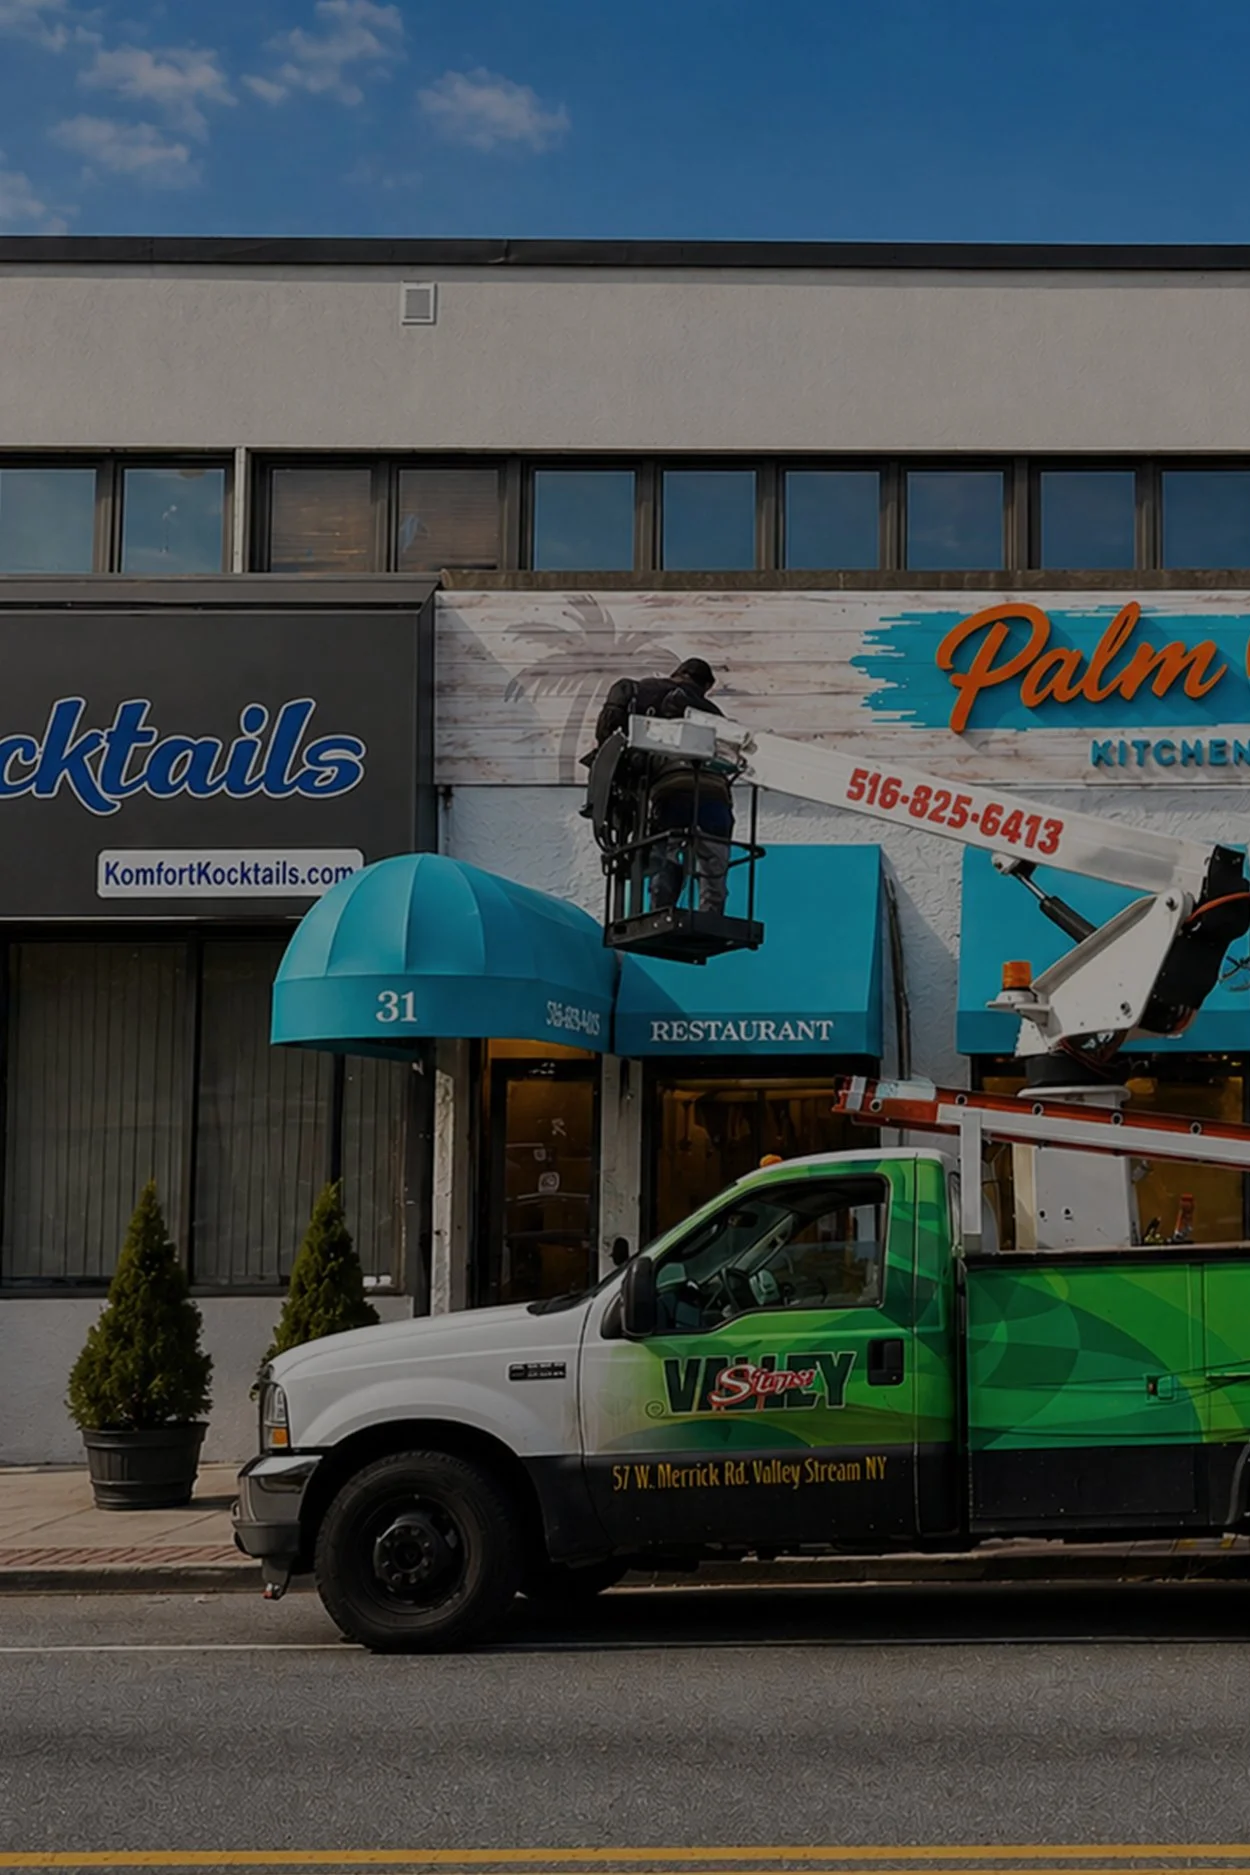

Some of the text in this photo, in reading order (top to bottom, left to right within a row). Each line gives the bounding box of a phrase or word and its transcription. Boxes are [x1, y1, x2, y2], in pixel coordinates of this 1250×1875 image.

[935, 601, 1228, 734] Palm
[104, 860, 353, 887] KomfortKocktails.com
[375, 989, 418, 1023] 31
[650, 1019, 834, 1042] RESTAURANT
[633, 1463, 656, 1490] W.
[657, 1462, 720, 1489] Merrick
[724, 1460, 749, 1486] Rd.
[752, 1458, 800, 1490] Valley
[804, 1455, 861, 1483] Stream
[864, 1455, 888, 1480] NY
